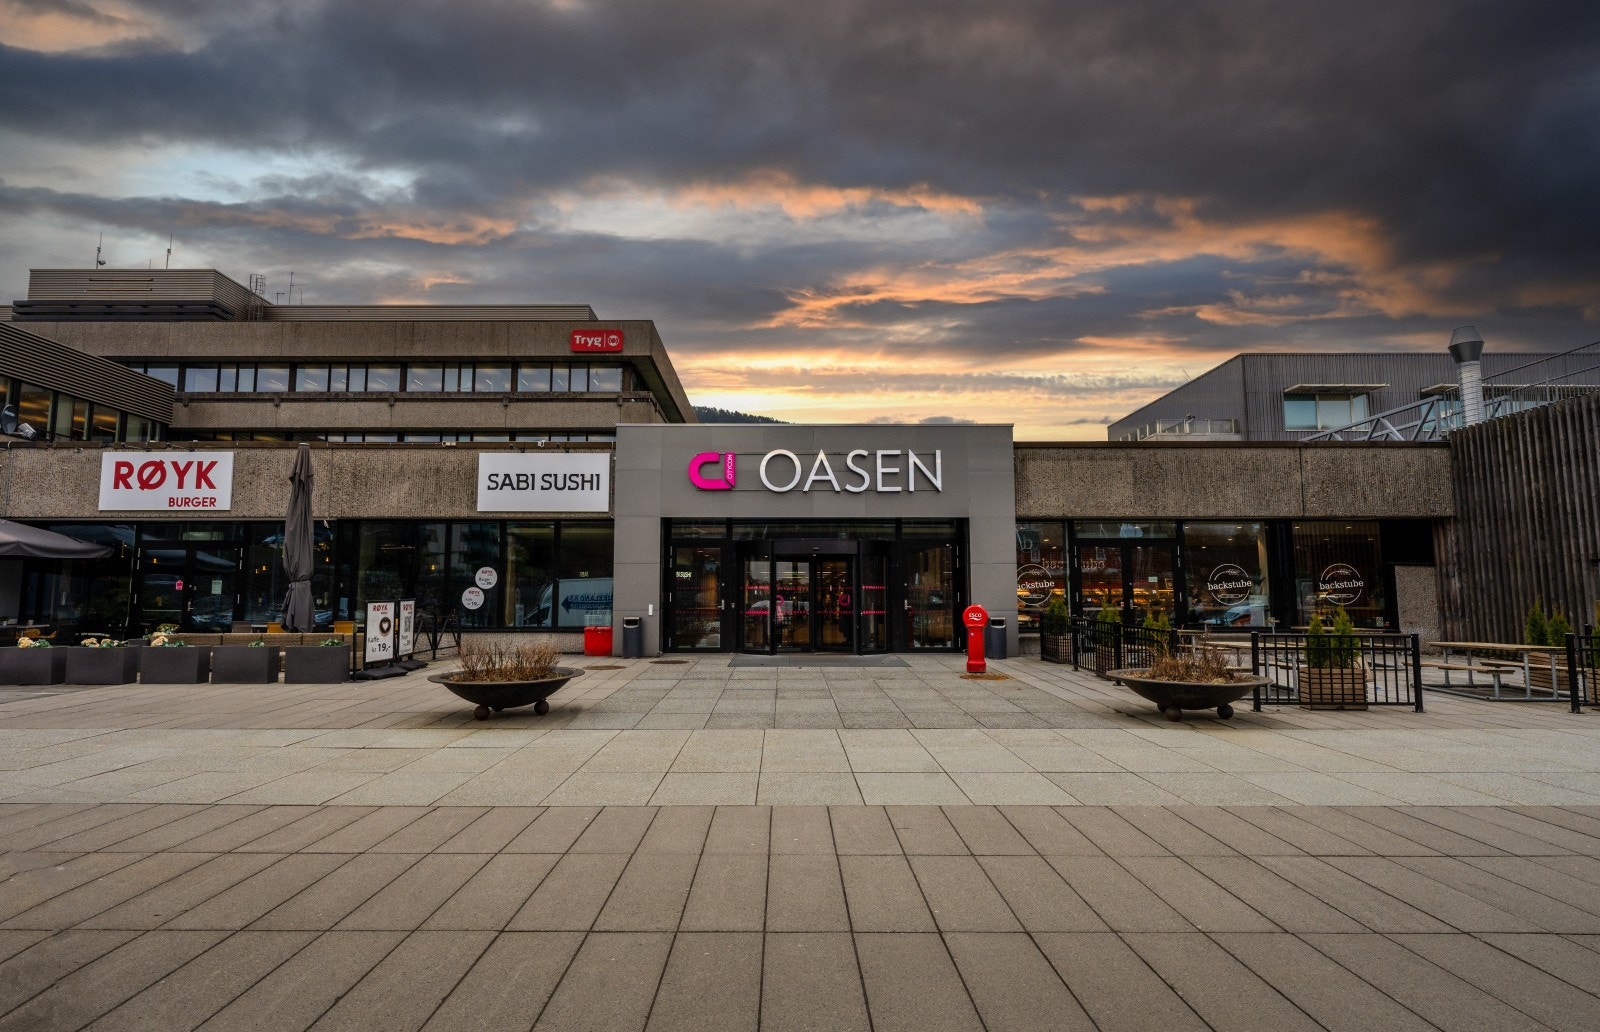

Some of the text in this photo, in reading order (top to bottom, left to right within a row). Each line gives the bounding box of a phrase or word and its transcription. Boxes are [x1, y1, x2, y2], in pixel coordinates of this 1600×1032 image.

[574, 335, 602, 347] Tryg
[113, 460, 219, 491] RØYK
[760, 448, 942, 493] OASEN
[487, 474, 601, 491] SABI SUSHI
[168, 497, 217, 508] BURGER
[1017, 580, 1055, 590] ackstube
[1207, 580, 1252, 591] backstube
[1319, 580, 1364, 591] backstube
